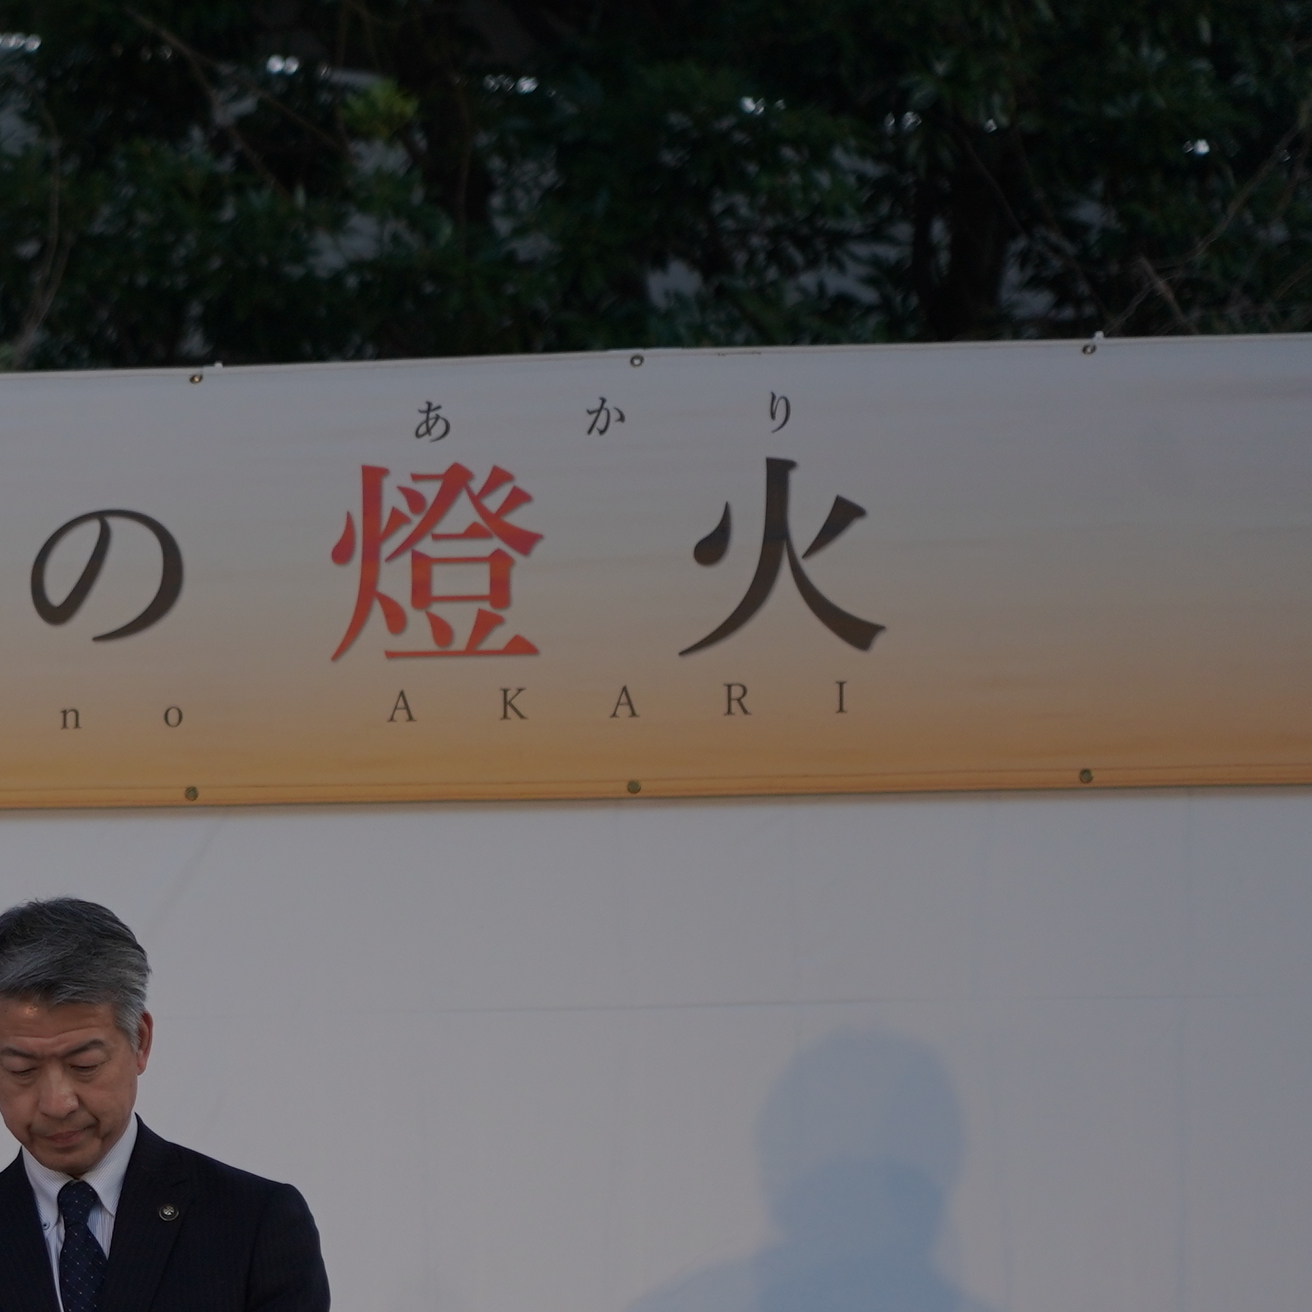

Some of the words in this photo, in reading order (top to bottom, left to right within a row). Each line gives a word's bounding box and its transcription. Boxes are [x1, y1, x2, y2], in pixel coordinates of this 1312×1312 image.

[414, 390, 792, 443] あかり
[59, 705, 185, 732] no
[386, 680, 849, 724] AKARI
